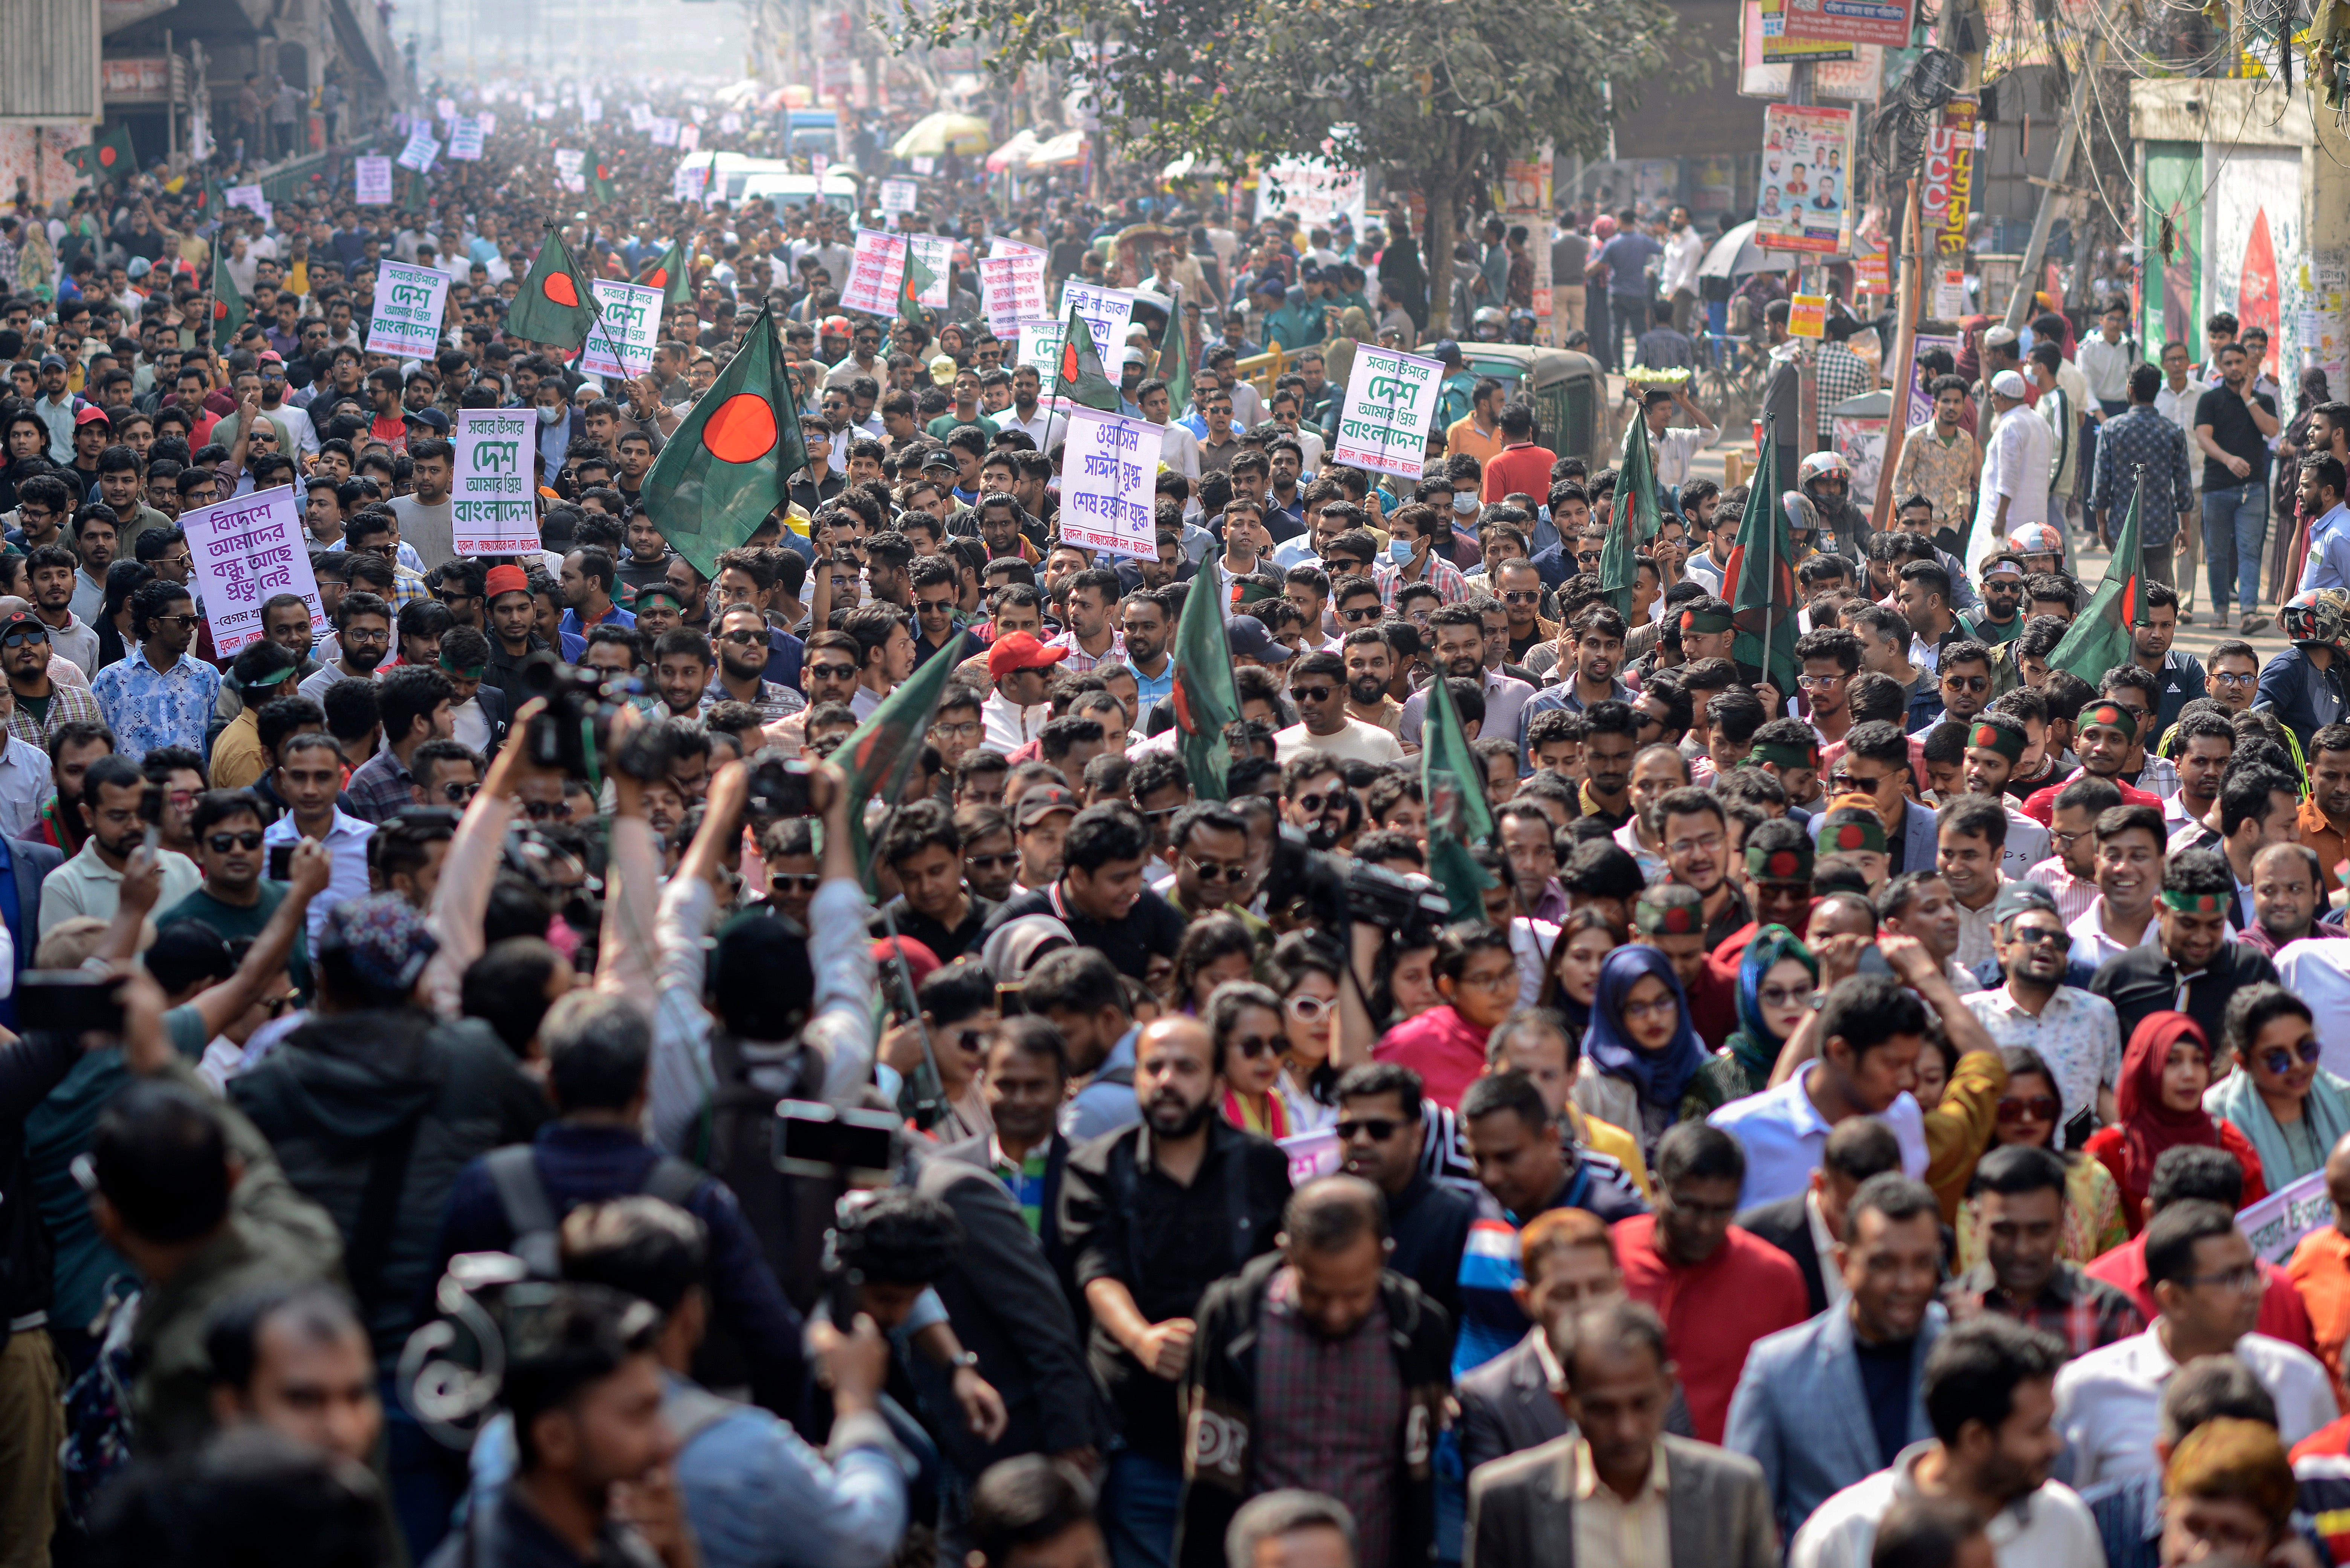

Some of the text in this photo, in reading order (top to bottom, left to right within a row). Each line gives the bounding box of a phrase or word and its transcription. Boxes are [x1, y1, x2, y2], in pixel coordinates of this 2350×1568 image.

[856, 250, 905, 270] আধিপত্যবা
[390, 269, 439, 287] সবার উপরে
[391, 284, 432, 308] দেশ
[603, 288, 652, 305] সবার উপরে
[385, 305, 431, 322] আমার প্রিয়
[606, 303, 646, 327] দেশ
[373, 318, 437, 340] বাংলাদেশ
[628, 326, 646, 341] প্রিয়
[1031, 326, 1055, 335] সবার
[1036, 338, 1064, 358] দে
[1366, 356, 1430, 381] সবার উপরে
[1368, 376, 1420, 409] দেশ
[468, 415, 525, 436] সবার উপরে
[1358, 402, 1418, 427] আমার প্রিয়
[1096, 419, 1139, 451] ওয়াসিম
[1342, 418, 1424, 452] বাংলাদেশ
[473, 441, 519, 472] দেশ
[1338, 448, 1355, 460] যুবদল
[1389, 459, 1397, 469] দল
[1402, 462, 1420, 473] ছাত্রদল
[466, 472, 522, 494] আমার প্রিয়
[1123, 461, 1142, 492] মুগ্ধ
[209, 504, 272, 534] বিদেশে
[454, 500, 532, 522] বাংলাদেশ
[1073, 491, 1149, 532] শেষ হয়নি যুদ্ধ
[206, 523, 285, 557] আমাদের
[457, 539, 539, 554] যুবদল স্বেচ্ছাসেবক দল ছাত্রদল
[1063, 528, 1153, 554] যুবদল স্বেচ্ছাসেবক দল ছাত্রদল
[211, 544, 293, 582] বন্ধু আছে
[226, 565, 292, 602] প্রভু নেই
[215, 611, 249, 626] -বেগম
[219, 636, 241, 655] যুবদল
